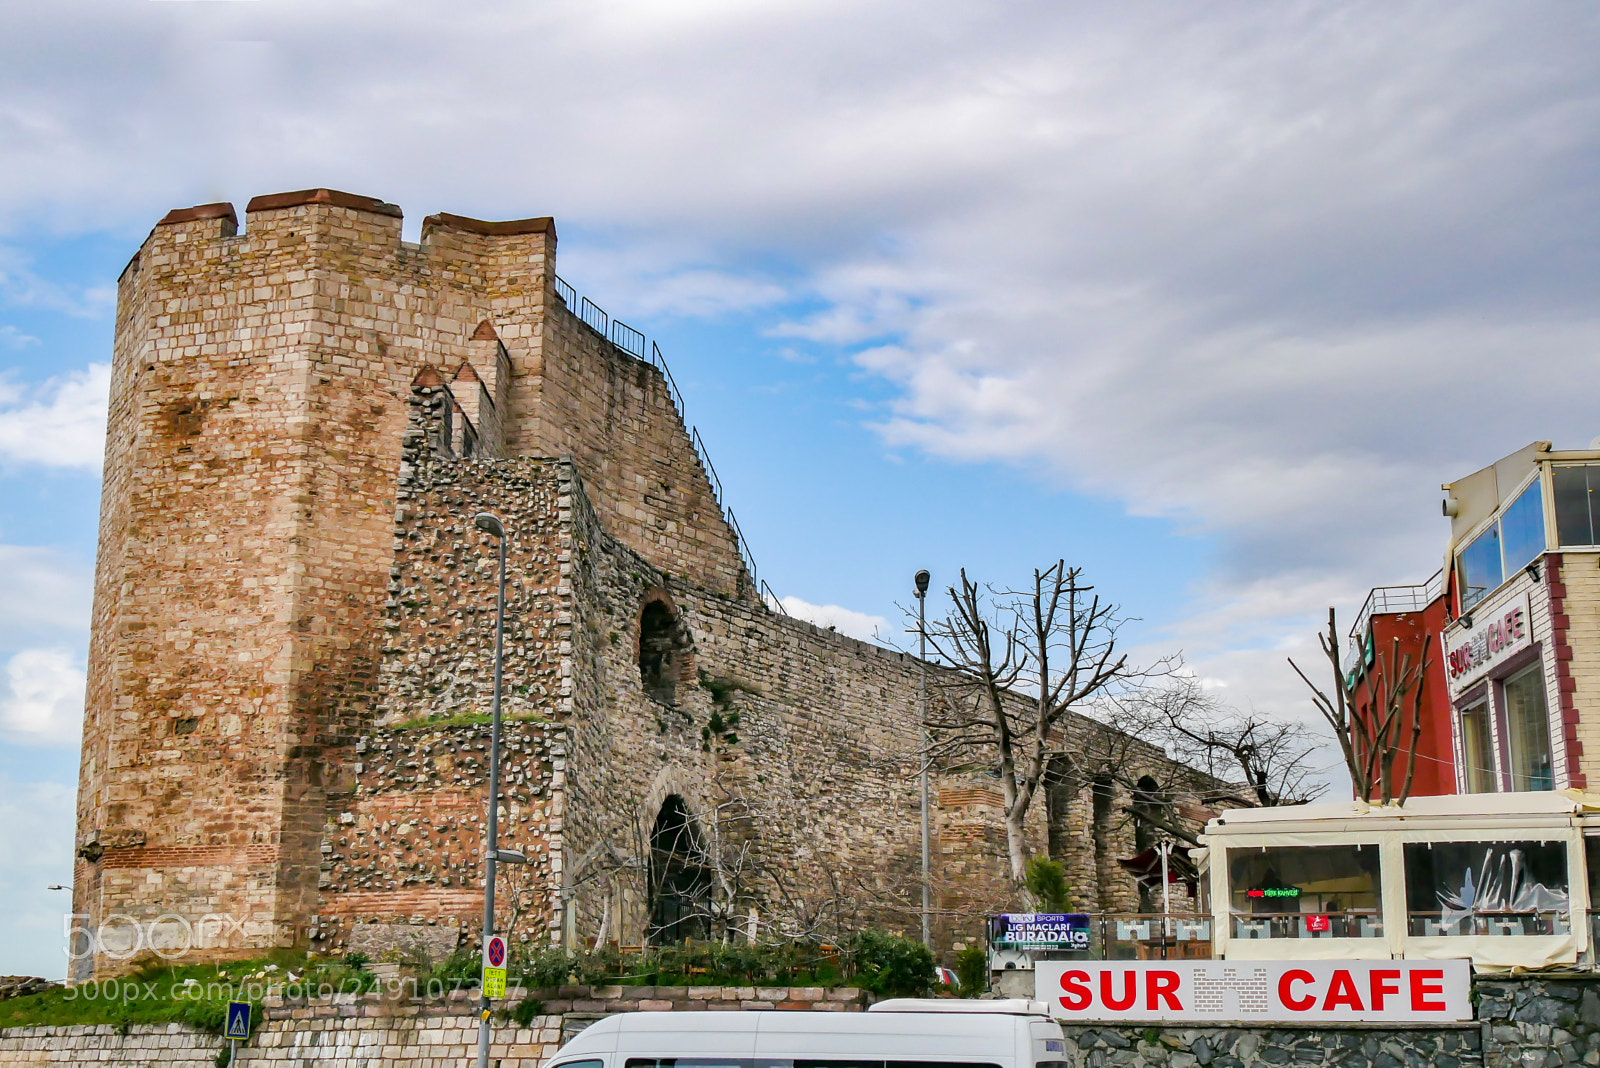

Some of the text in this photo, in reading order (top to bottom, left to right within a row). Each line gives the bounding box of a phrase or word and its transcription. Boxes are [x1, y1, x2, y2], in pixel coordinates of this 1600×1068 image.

[1449, 606, 1524, 679] SUR CAFE
[1005, 931, 1074, 942] BURADA!
[1059, 969, 1446, 1012] SUR CAFE
